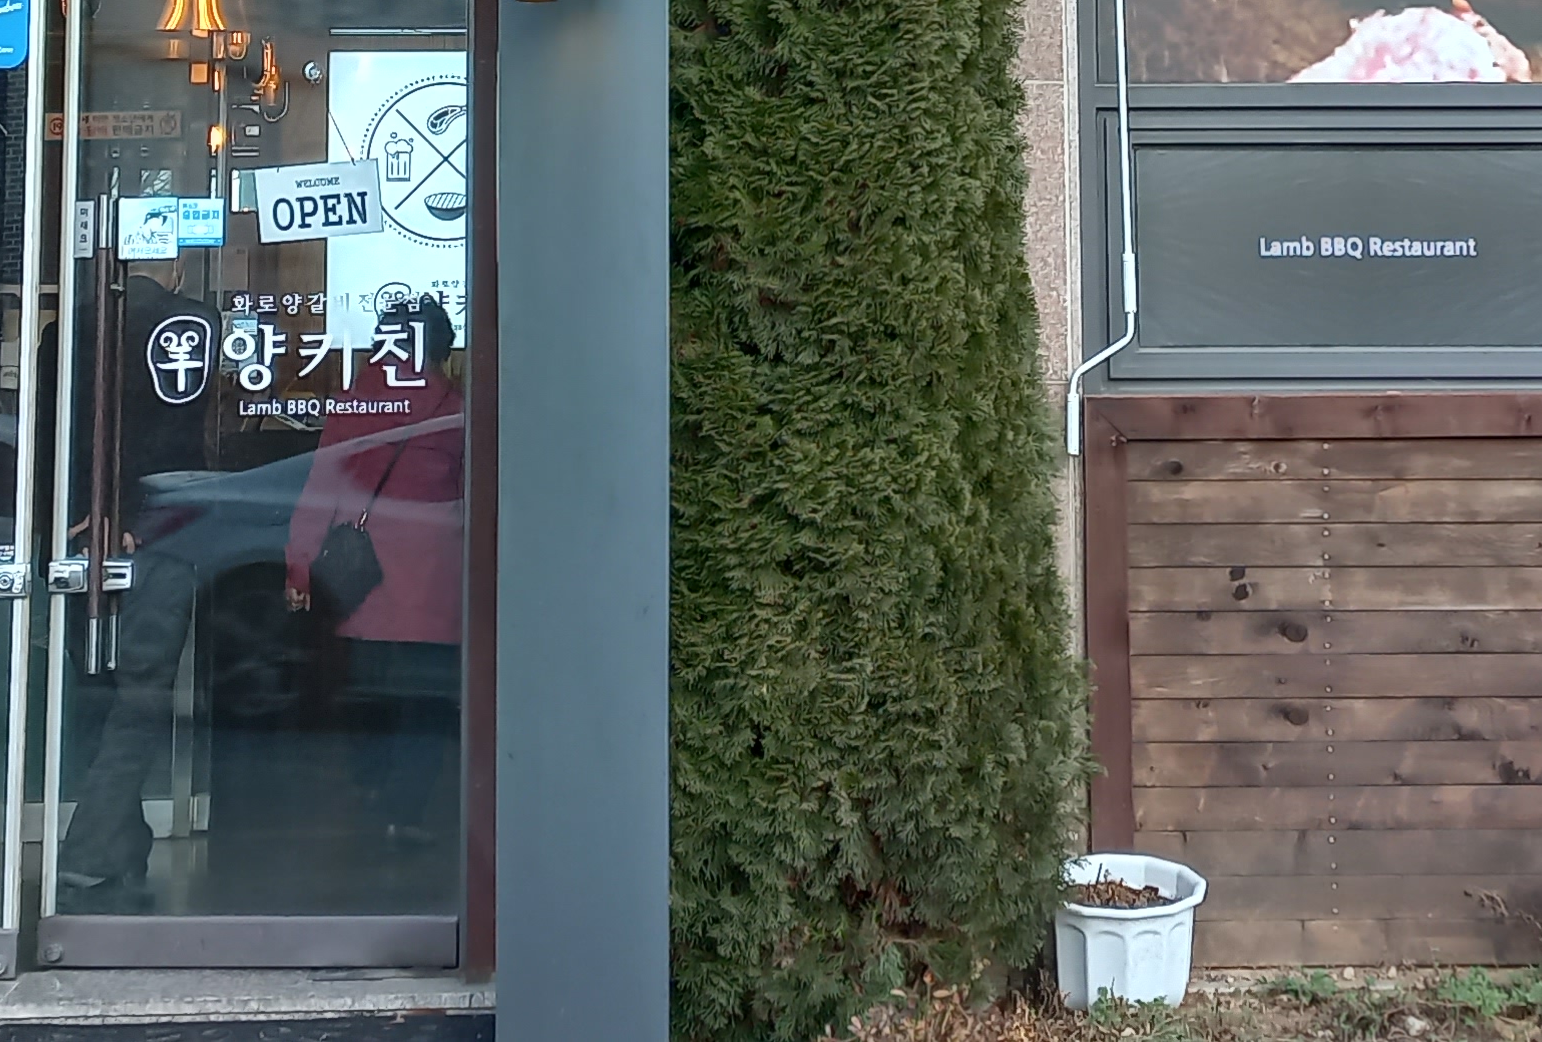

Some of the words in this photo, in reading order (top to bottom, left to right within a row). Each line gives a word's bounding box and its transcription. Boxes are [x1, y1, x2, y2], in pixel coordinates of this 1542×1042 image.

[295, 176, 340, 188] WELCOME
[272, 191, 368, 231] OPEN
[1259, 235, 1315, 257] Lamb
[1320, 236, 1363, 260] BBQ
[1368, 236, 1477, 257] Restaurant
[222, 321, 426, 392] 양키친
[239, 399, 281, 416] Lamb
[287, 399, 321, 418] BBQ
[326, 398, 411, 415] Restaurant
